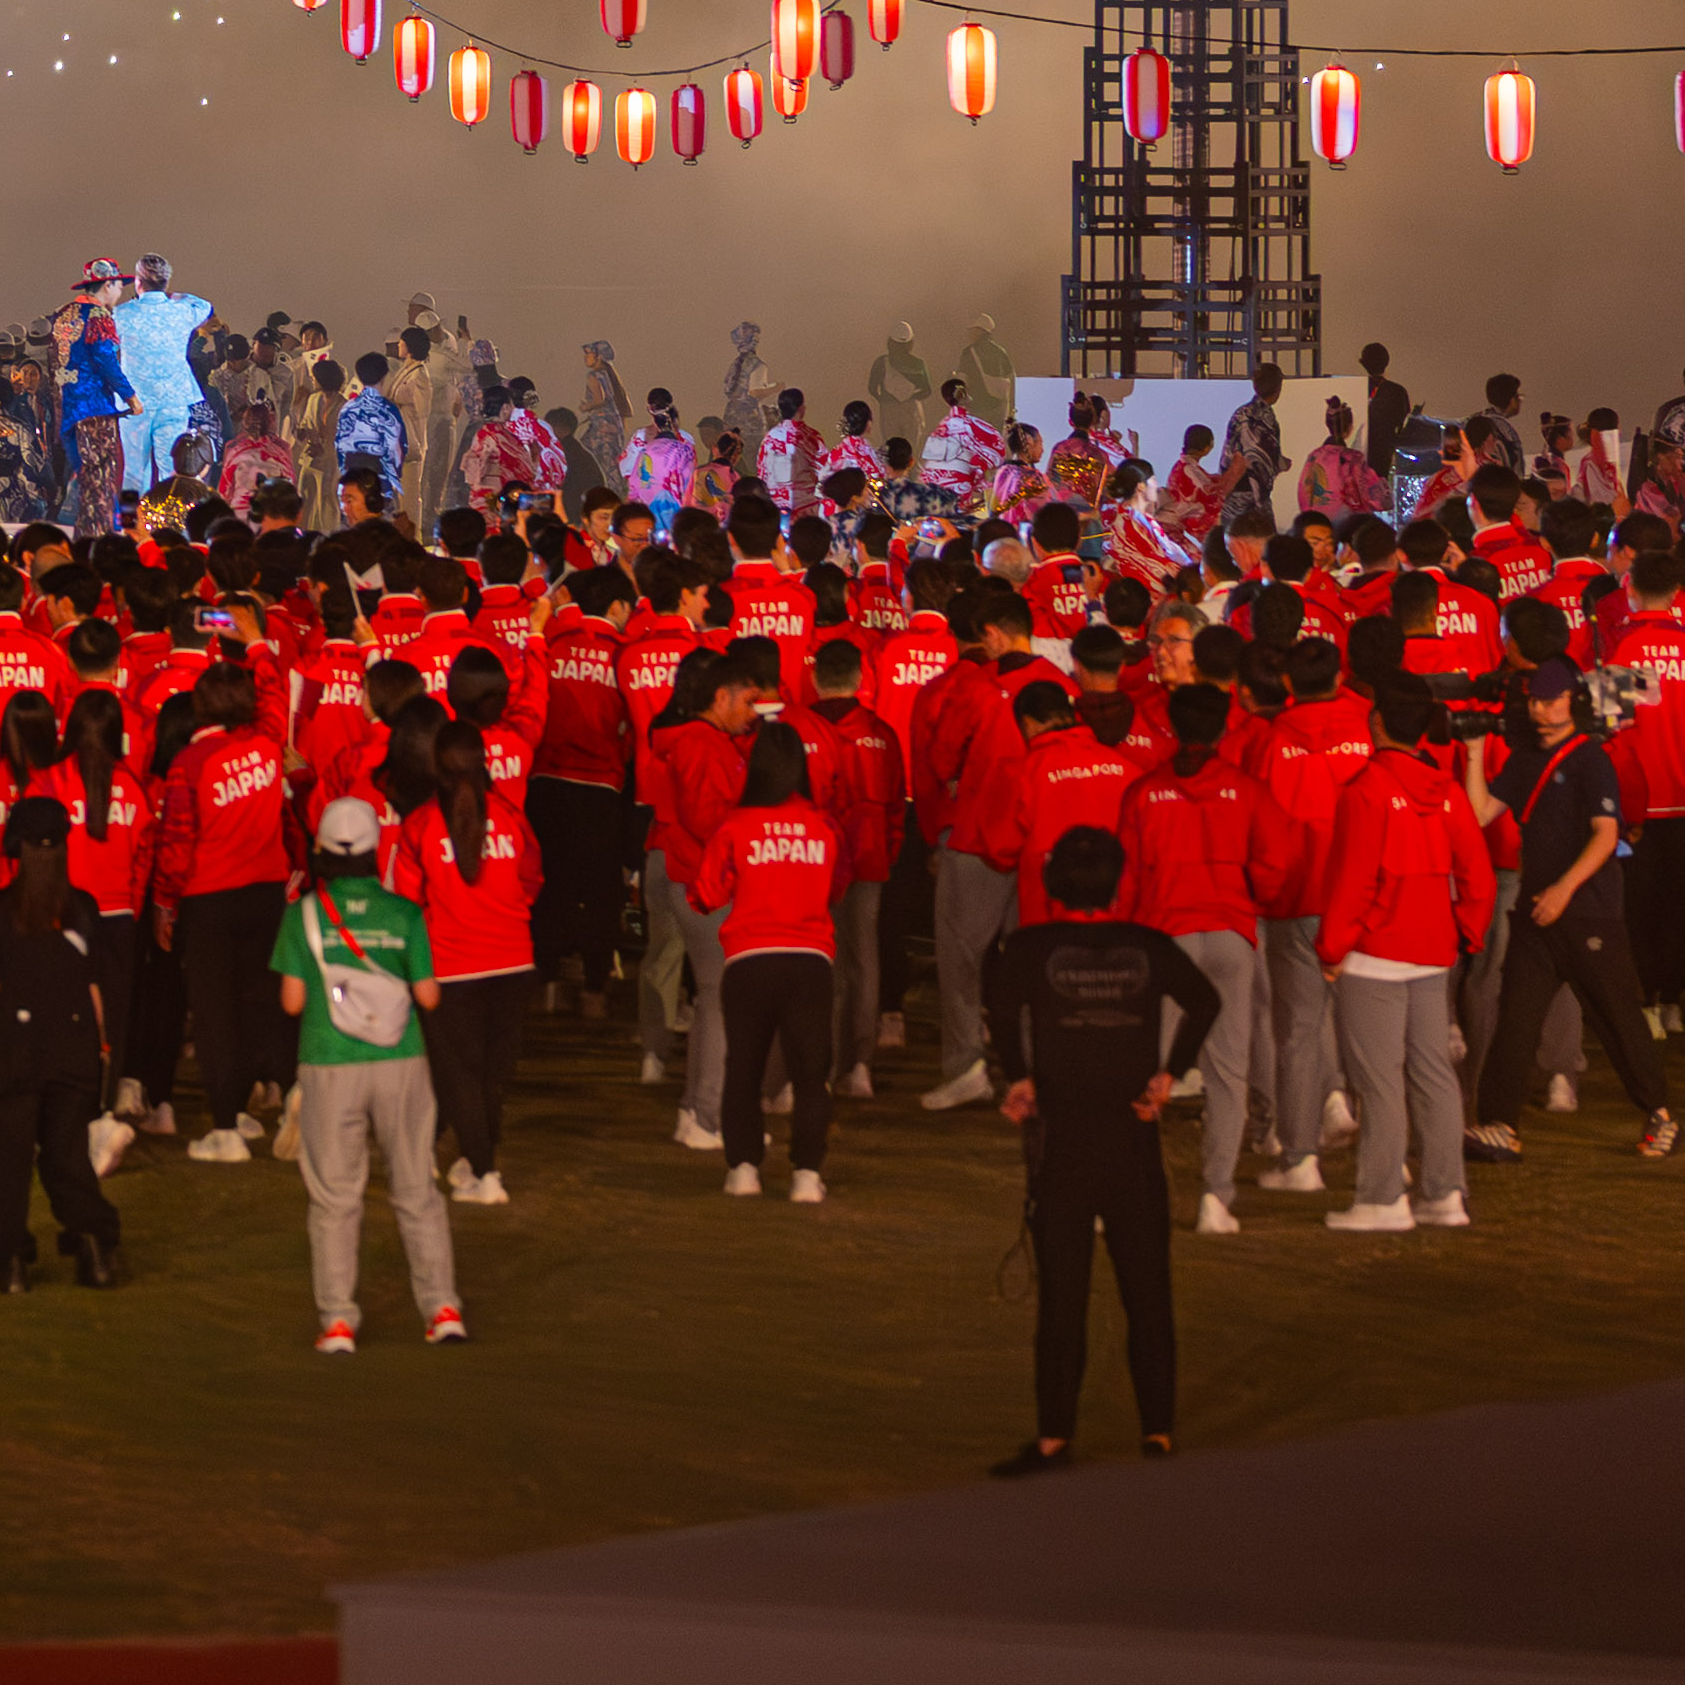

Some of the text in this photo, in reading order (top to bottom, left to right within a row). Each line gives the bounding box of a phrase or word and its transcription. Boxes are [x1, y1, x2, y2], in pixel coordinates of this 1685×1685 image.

[1504, 558, 1536, 574] TEAM
[750, 602, 788, 613] TEAM
[1053, 594, 1087, 616] APA
[1439, 601, 1459, 612] AM
[493, 618, 529, 631] TEAM
[736, 615, 803, 638] JAPAN
[1436, 613, 1477, 636] PAN
[433, 655, 451, 668] TE
[570, 647, 609, 663] TEAM
[641, 652, 680, 664] TEAM
[909, 650, 947, 663] TEAM
[1642, 646, 1679, 657] TEAM
[332, 669, 360, 682] TEA
[551, 658, 617, 689] JAPAN
[629, 666, 677, 690] JAP
[893, 663, 944, 685] JAP
[320, 683, 362, 706] JAP
[222, 751, 262, 775] TEAM
[213, 760, 276, 807] JAPAN
[70, 800, 136, 826] JAN
[763, 822, 805, 836] TEAM
[440, 834, 515, 863] JAN
[747, 838, 825, 865] JAPAN
